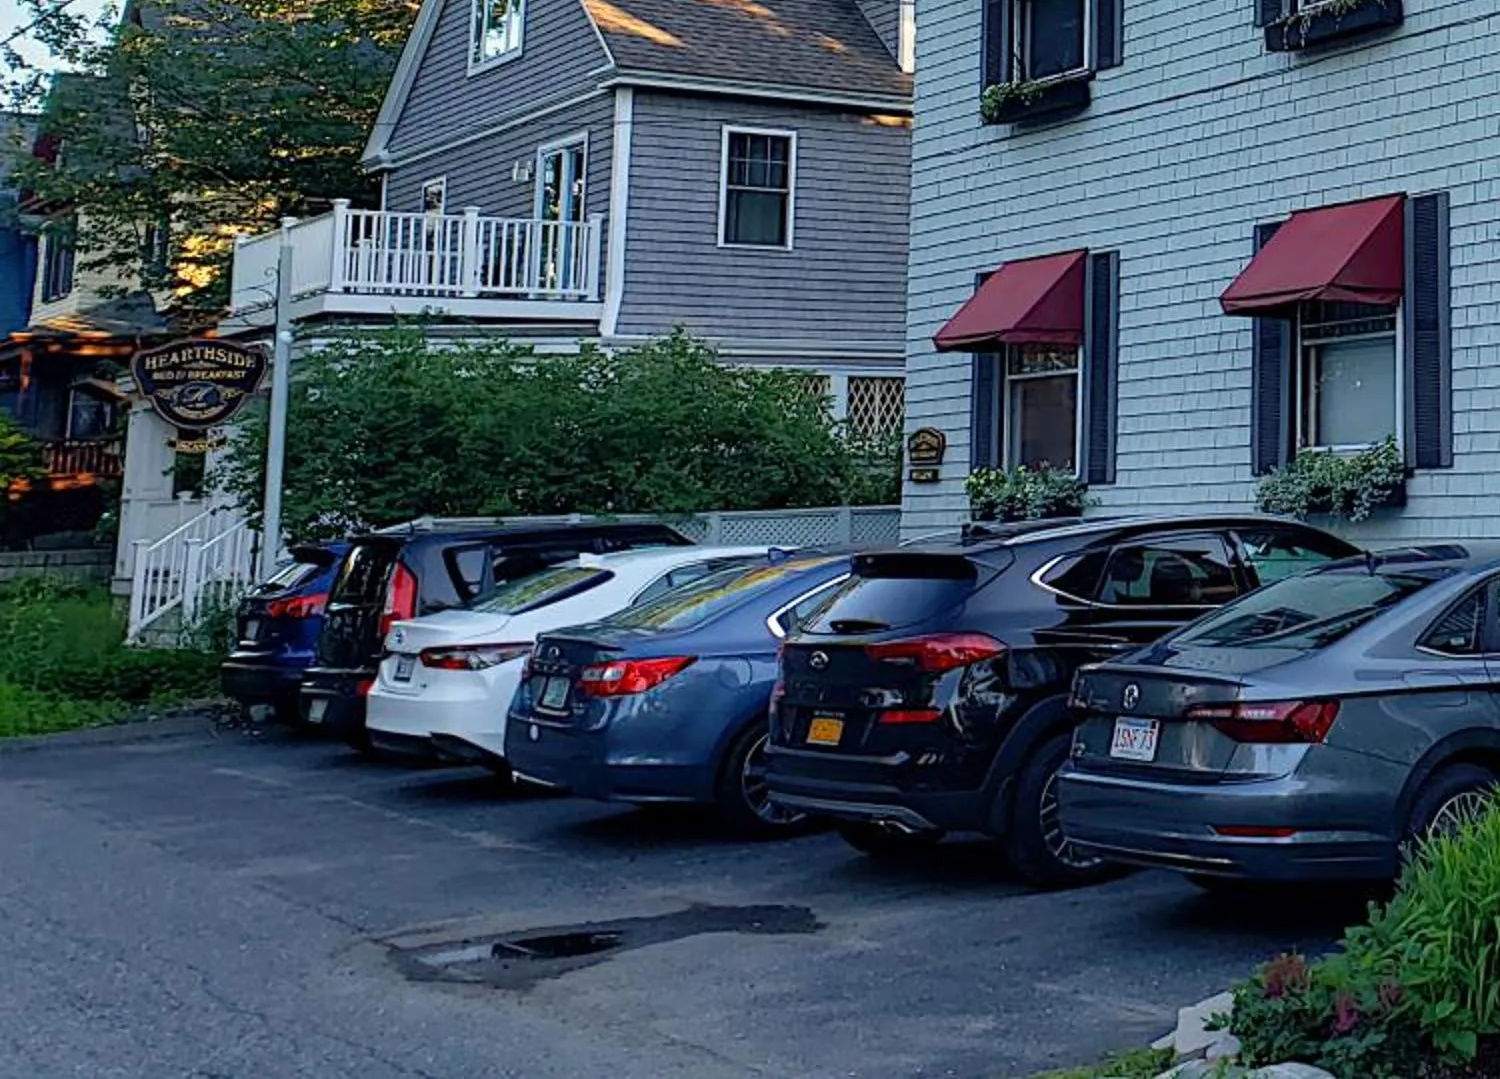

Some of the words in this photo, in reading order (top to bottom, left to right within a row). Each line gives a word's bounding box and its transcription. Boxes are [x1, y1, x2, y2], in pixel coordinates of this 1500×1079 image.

[145, 346, 256, 369] HEARTHSIDE
[152, 371, 174, 380] BED
[187, 370, 247, 380] BREAKFAST
